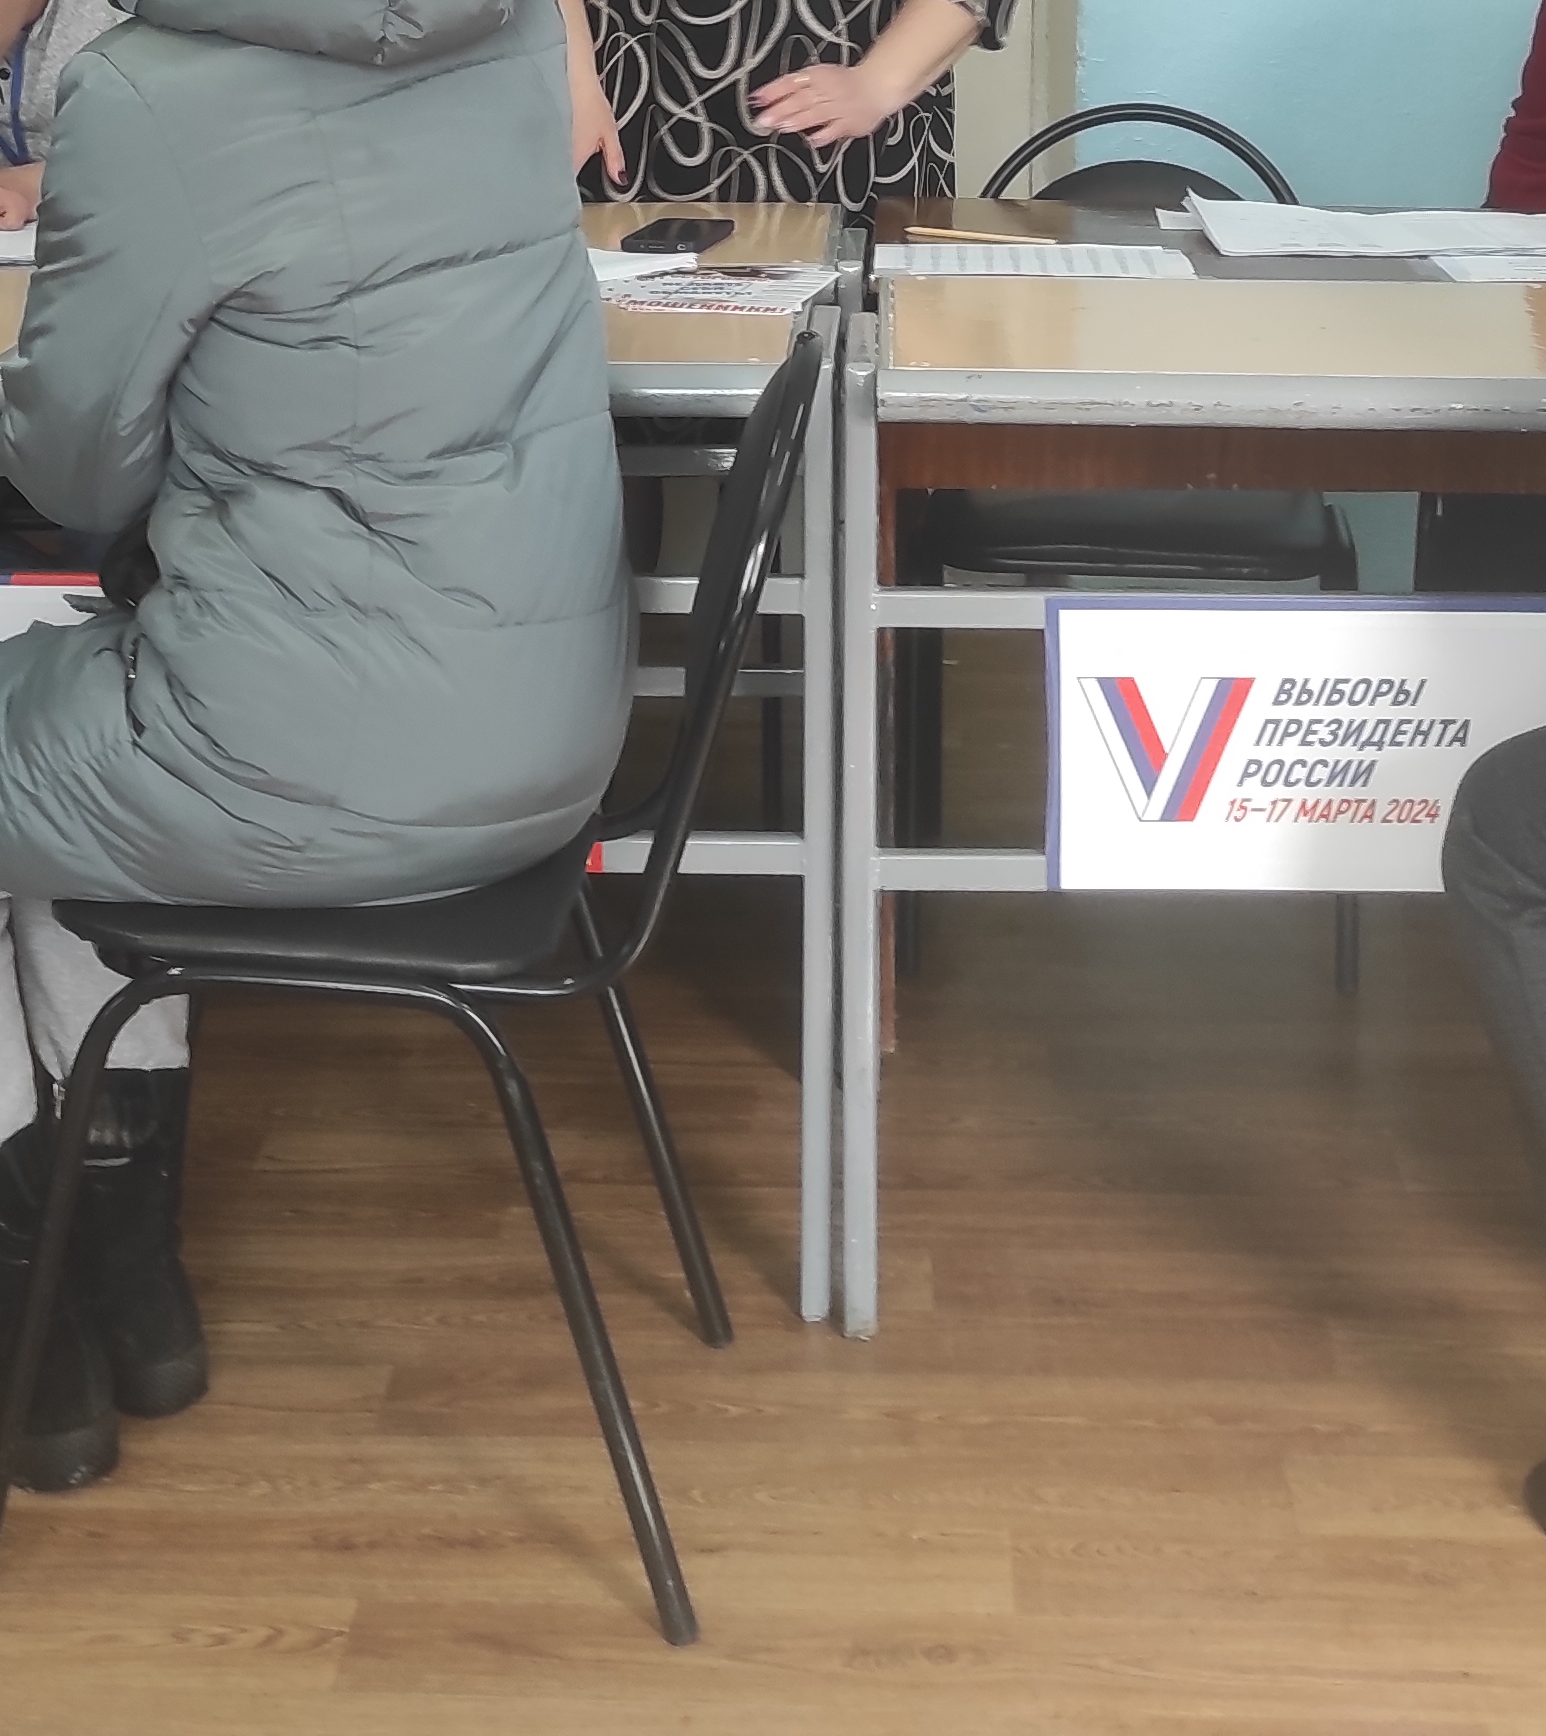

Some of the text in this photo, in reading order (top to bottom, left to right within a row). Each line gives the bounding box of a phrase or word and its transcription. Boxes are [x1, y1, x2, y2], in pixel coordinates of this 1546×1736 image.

[626, 300, 788, 314] МОШЕННИКИ!
[1271, 677, 1427, 708] ВЫБОРЫ
[1254, 718, 1470, 749] ПРЕЗИДЕНТА
[1237, 760, 1378, 787] РОССИИ
[1298, 799, 1376, 823] МАРТА
[1381, 799, 1440, 823] 2024
